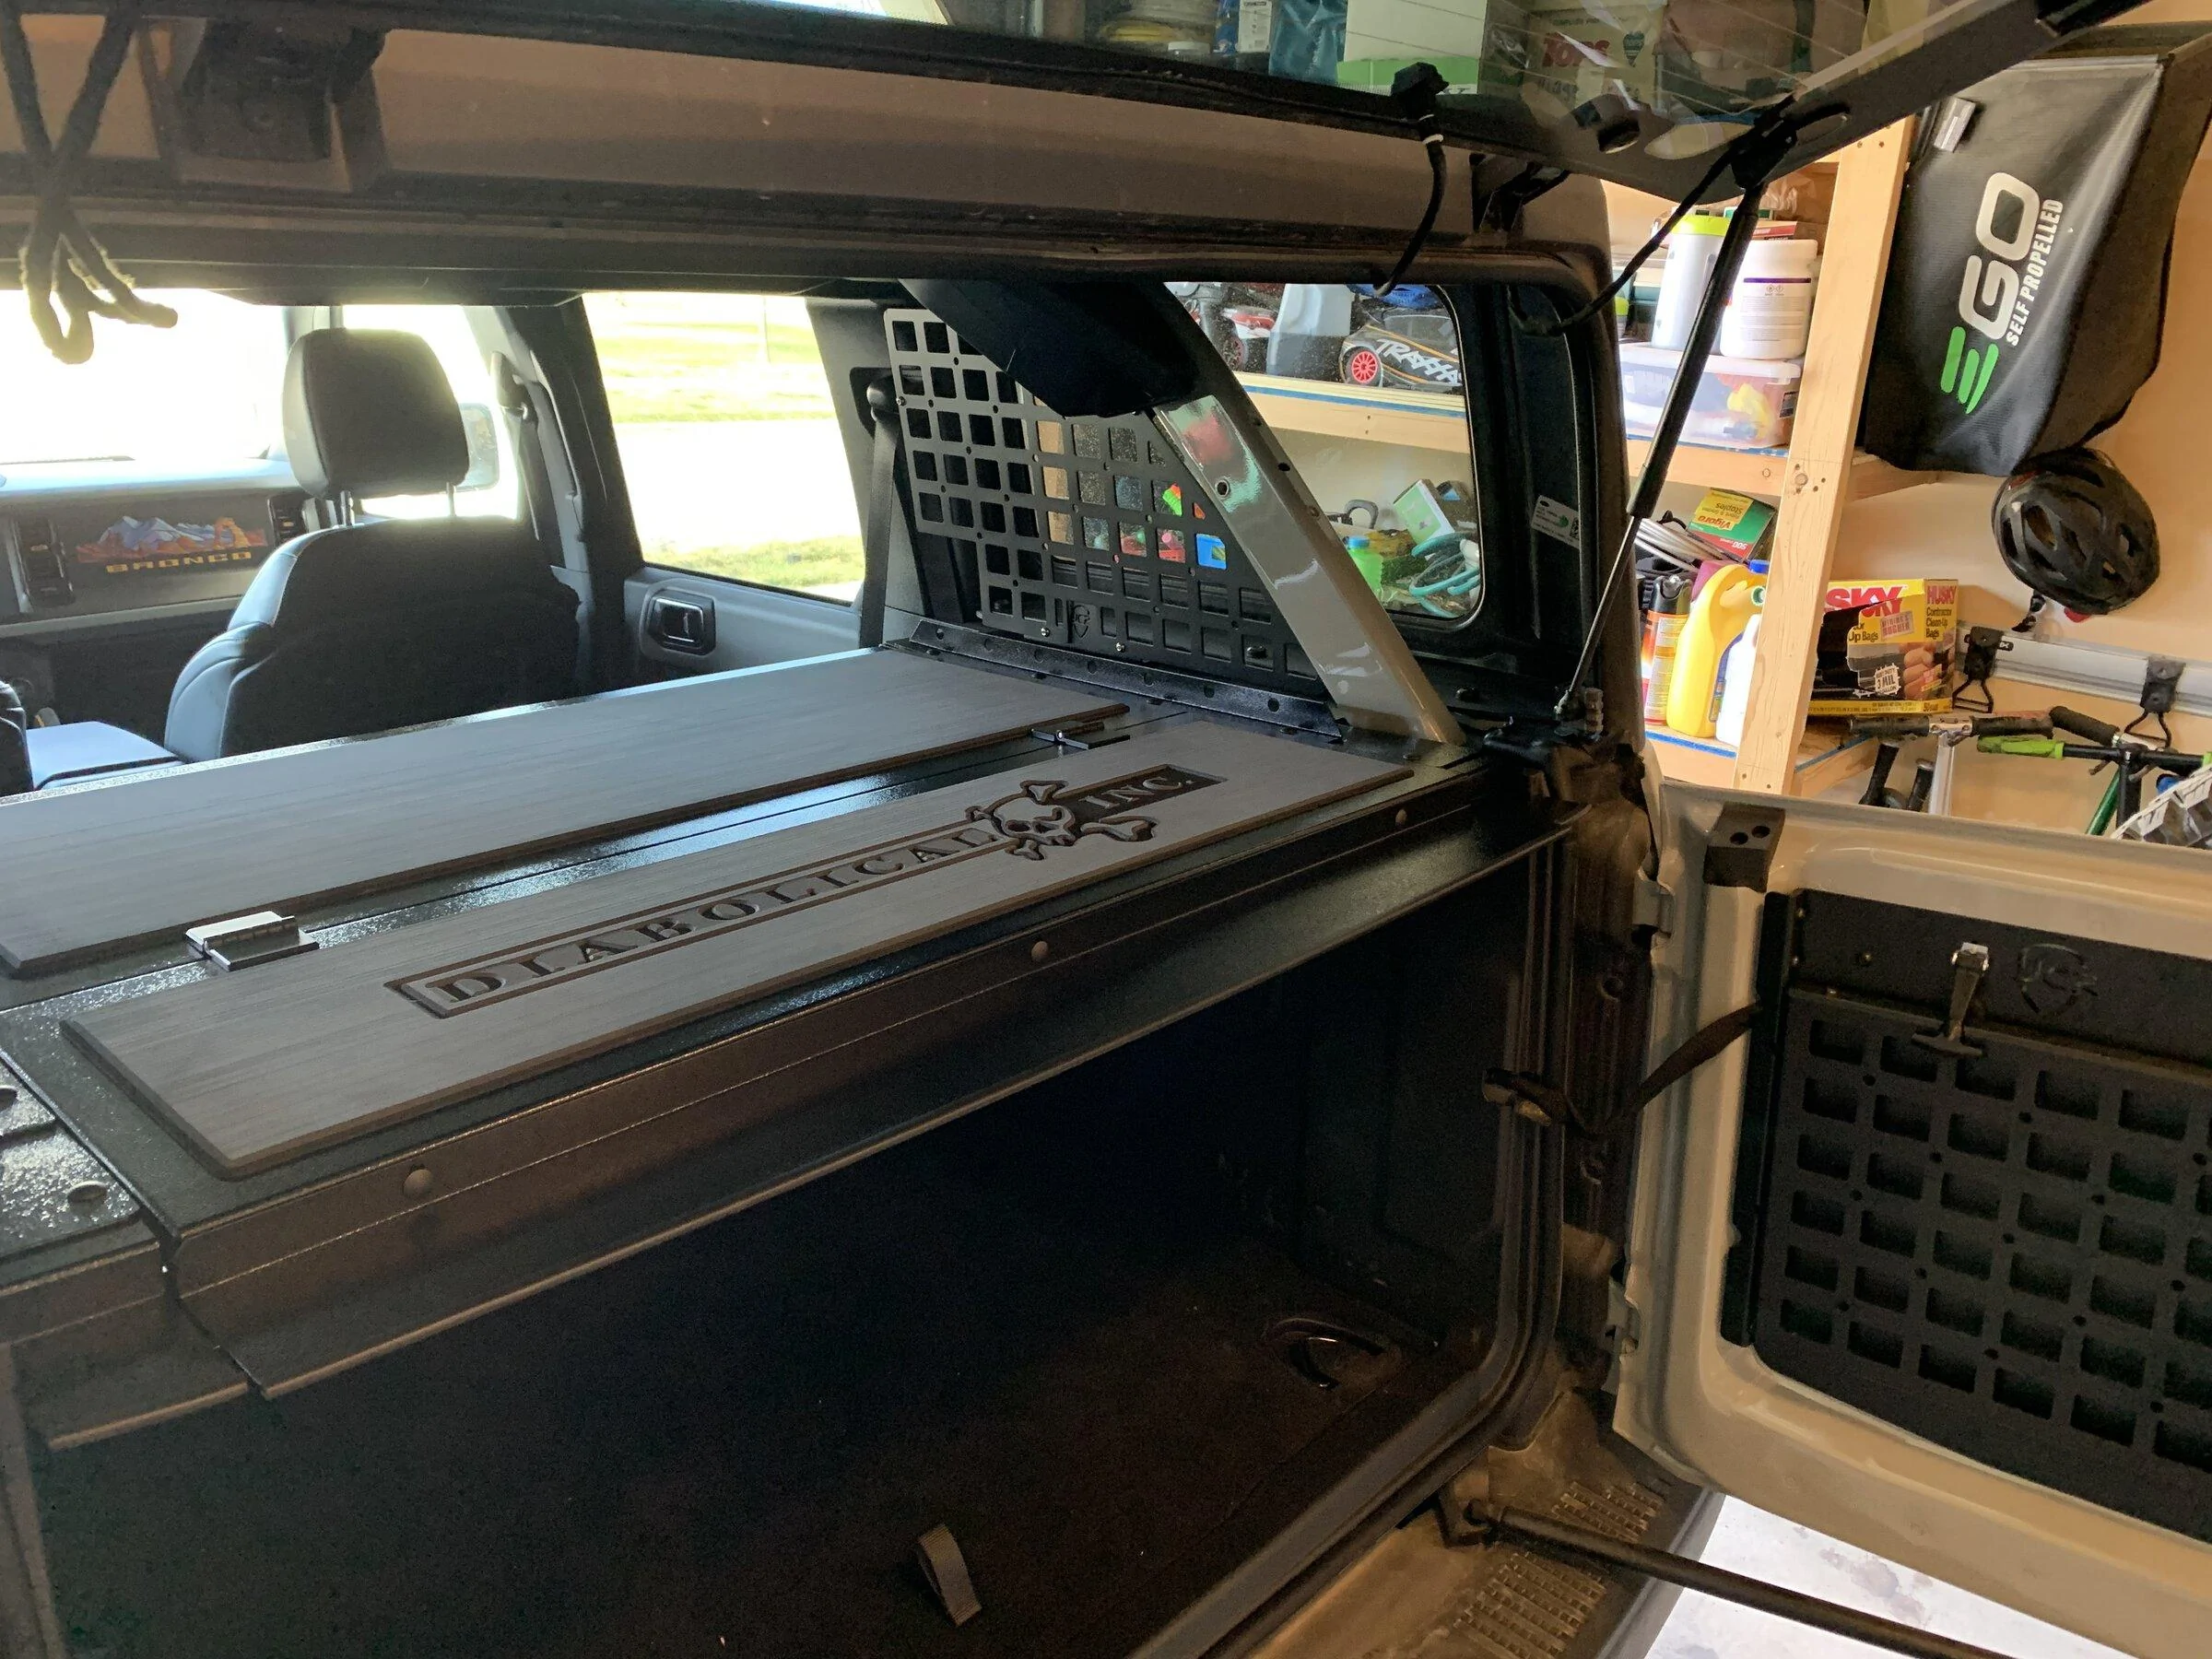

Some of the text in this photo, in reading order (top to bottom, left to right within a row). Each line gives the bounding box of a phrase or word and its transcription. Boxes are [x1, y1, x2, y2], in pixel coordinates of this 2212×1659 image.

[2006, 198, 2064, 347] SELF PROPELLED
[1698, 515, 1731, 528] Vigoro
[106, 551, 252, 573] BRONCO
[1825, 585, 1903, 617] SKY
[1926, 584, 1957, 605] HUSKY
[1861, 630, 1879, 642] Bags
[1925, 628, 1940, 641] Bags
[428, 776, 1194, 1002] DIABOLICAL INC.
